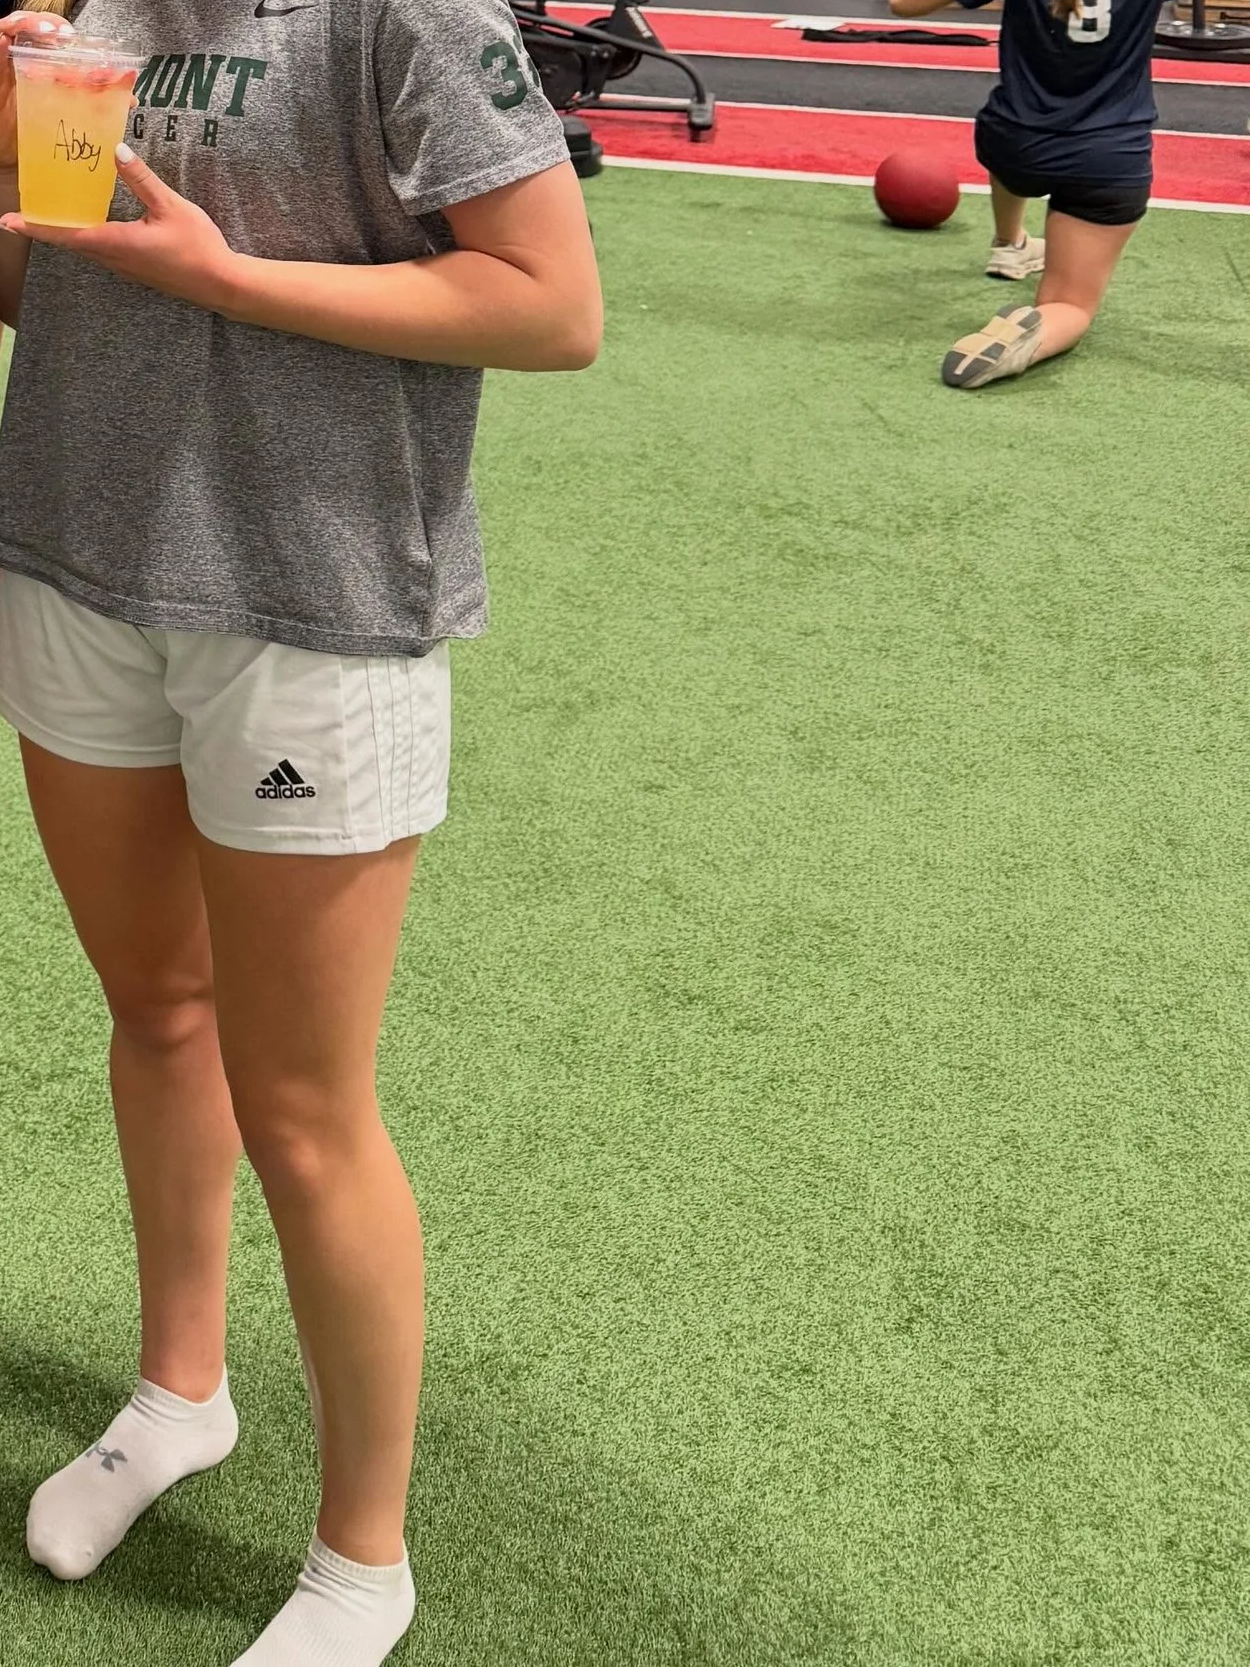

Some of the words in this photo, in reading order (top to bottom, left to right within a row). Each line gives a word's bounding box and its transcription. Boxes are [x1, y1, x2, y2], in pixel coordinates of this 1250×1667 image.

[132, 53, 268, 117] MONT
[53, 119, 102, 172] Abby
[133, 113, 219, 147] CER
[255, 783, 316, 799] adidas
